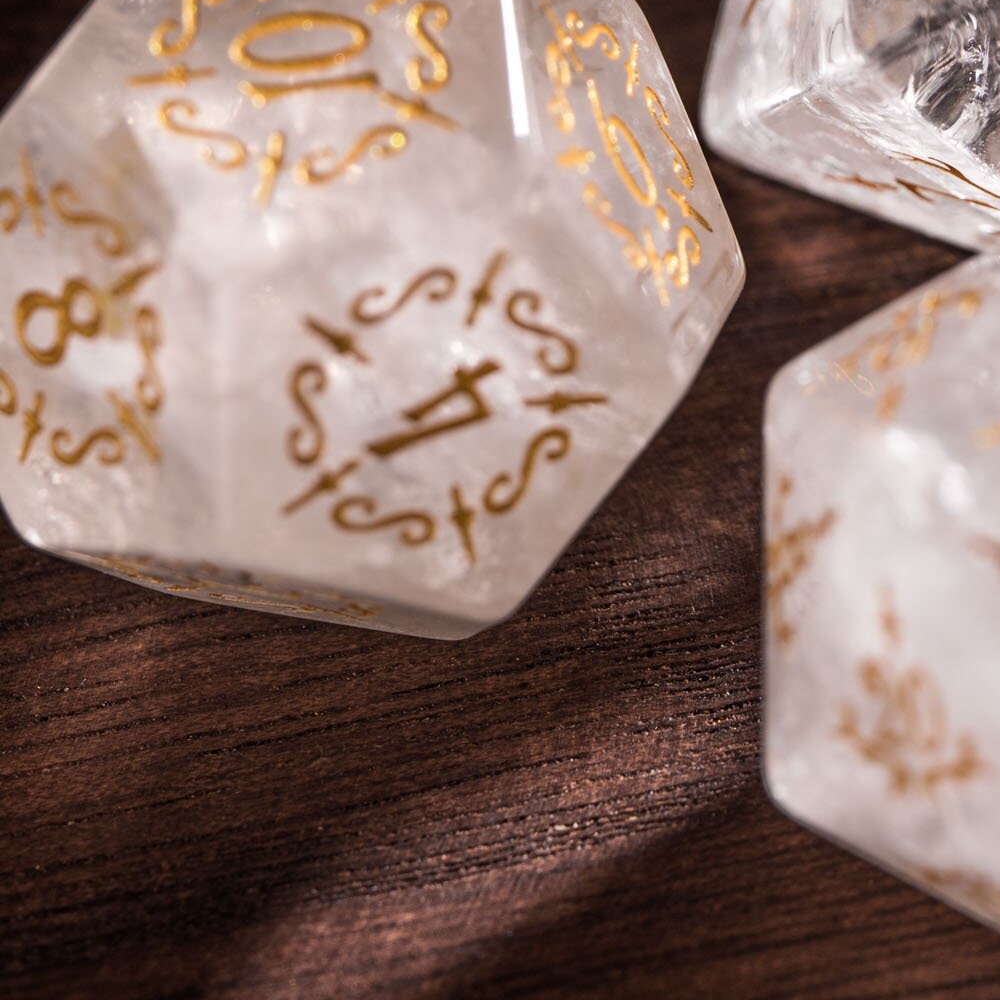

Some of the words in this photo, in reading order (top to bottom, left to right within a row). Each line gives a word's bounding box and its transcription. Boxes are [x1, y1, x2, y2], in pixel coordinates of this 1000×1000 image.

[227, 9, 380, 102] 10
[13, 277, 104, 367] 8
[366, 360, 503, 458] 4
